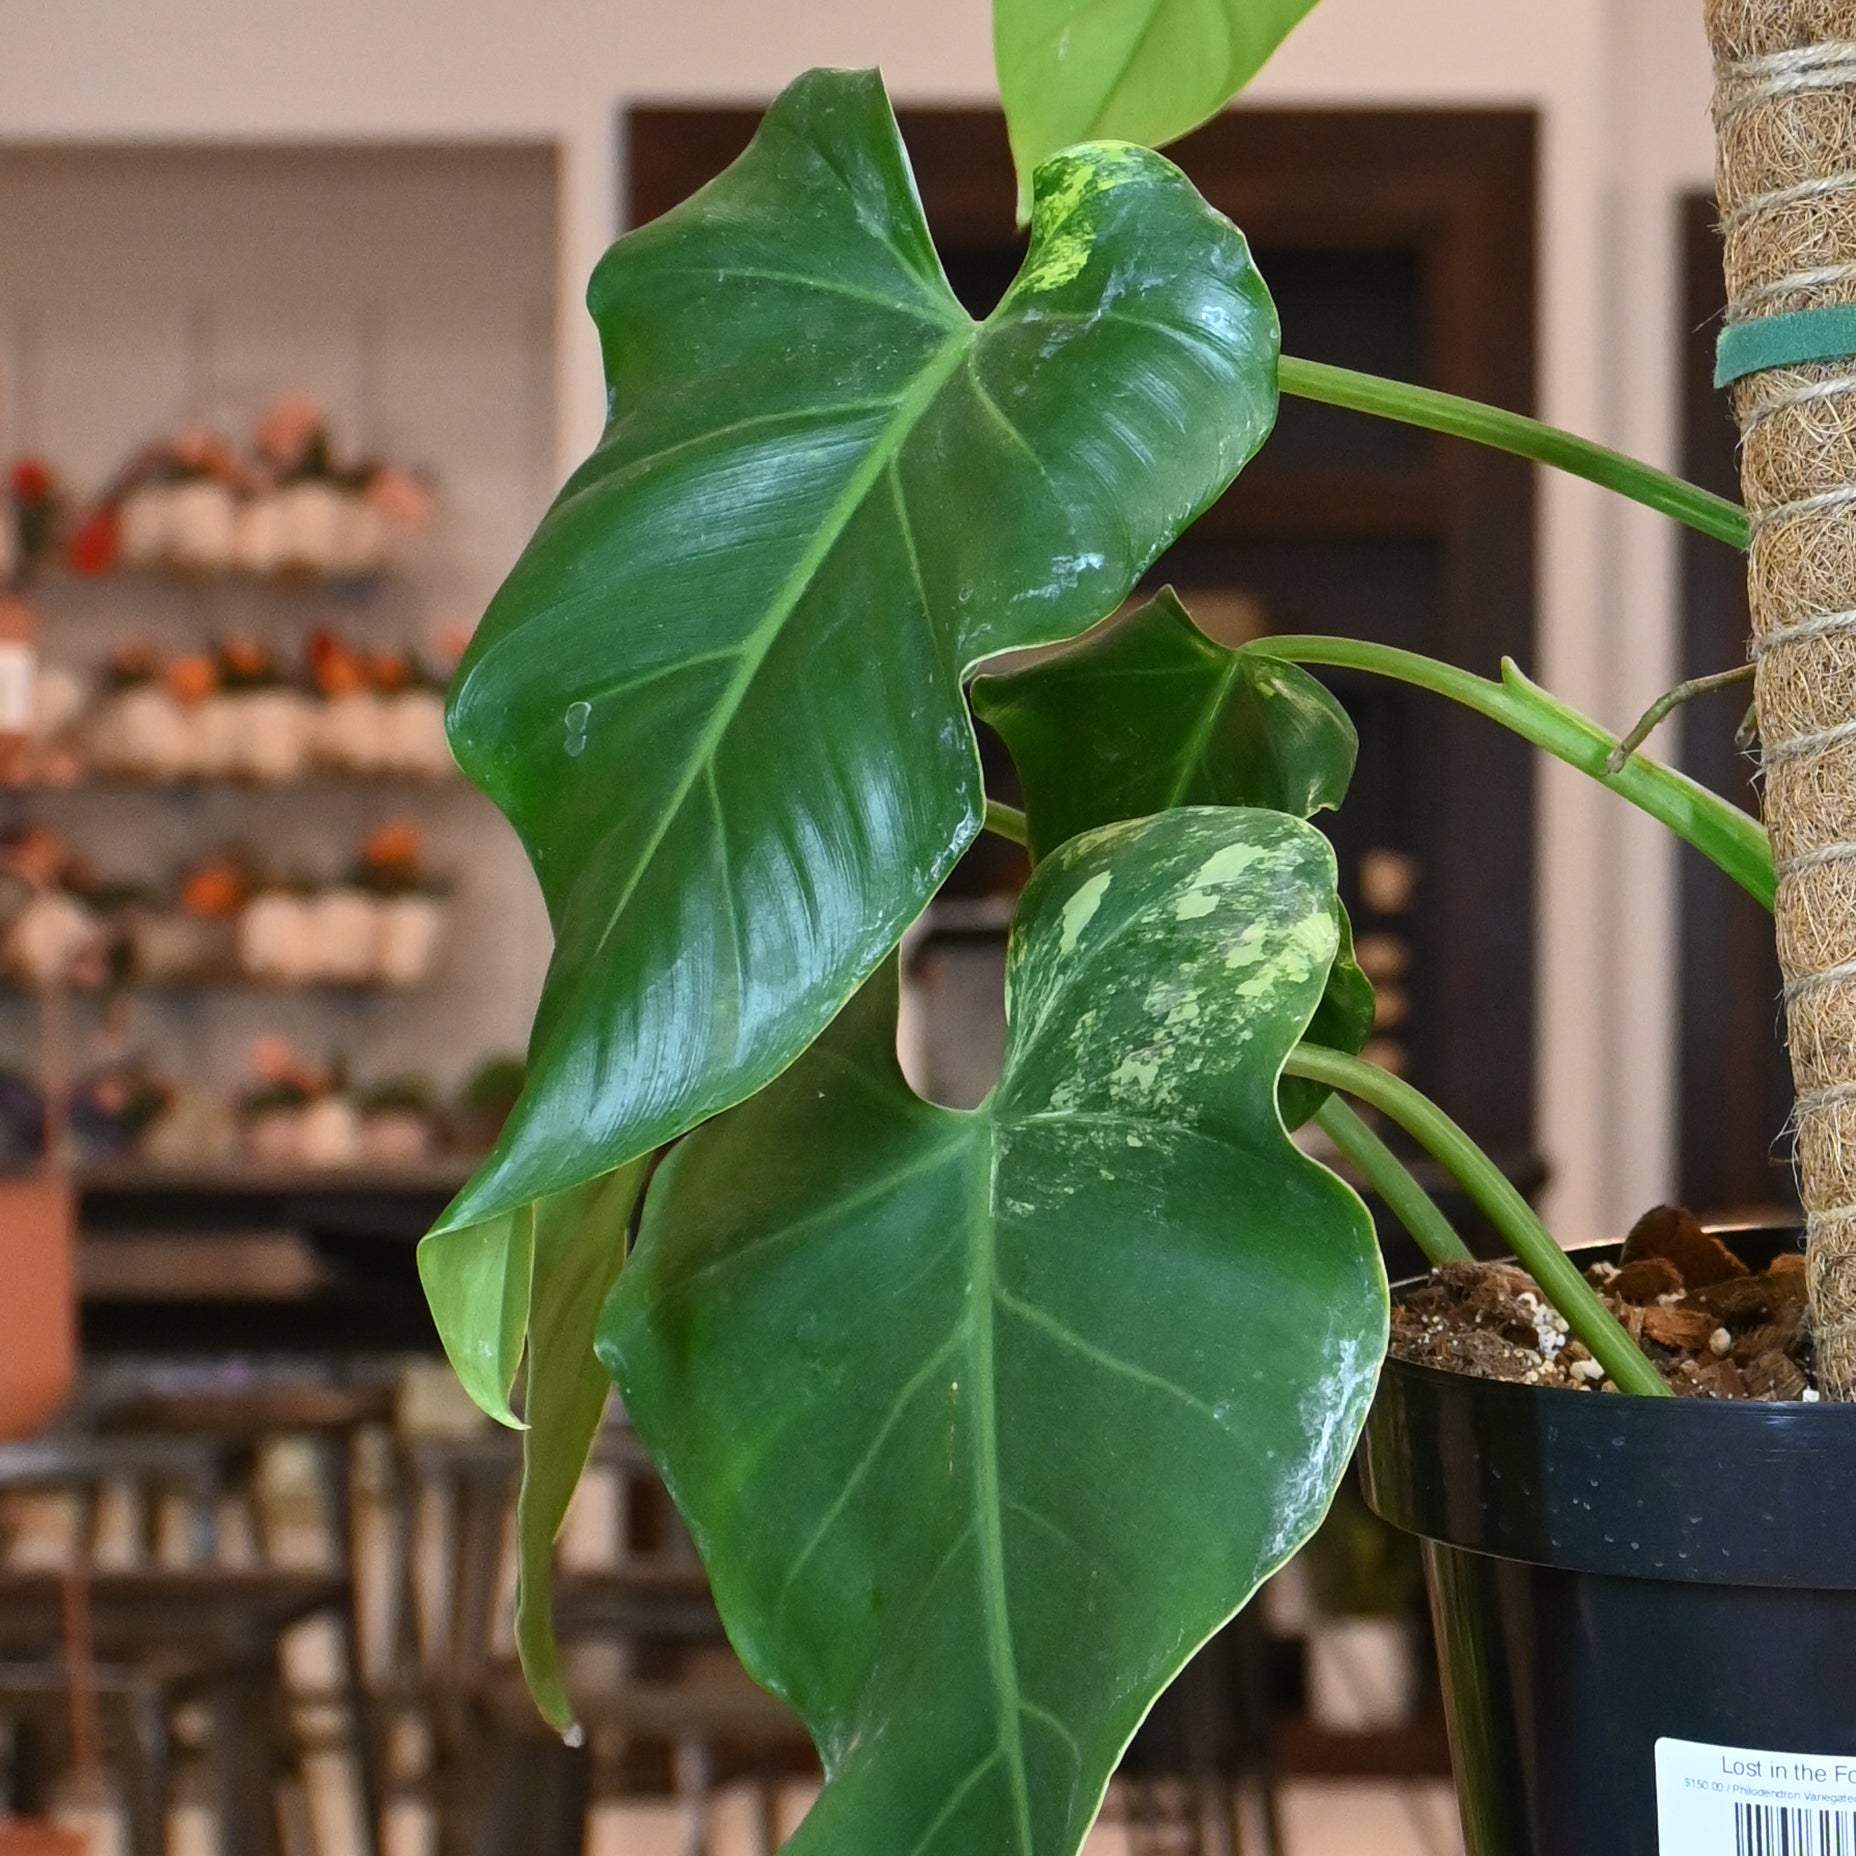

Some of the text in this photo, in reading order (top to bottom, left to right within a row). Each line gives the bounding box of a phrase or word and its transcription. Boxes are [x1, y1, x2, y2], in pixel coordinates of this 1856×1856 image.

[1722, 1756, 1763, 1777] Lost
[1770, 1761, 1787, 1780] in
[1794, 1763, 1827, 1783] the
[1733, 1784, 1801, 1800] Philodendron
